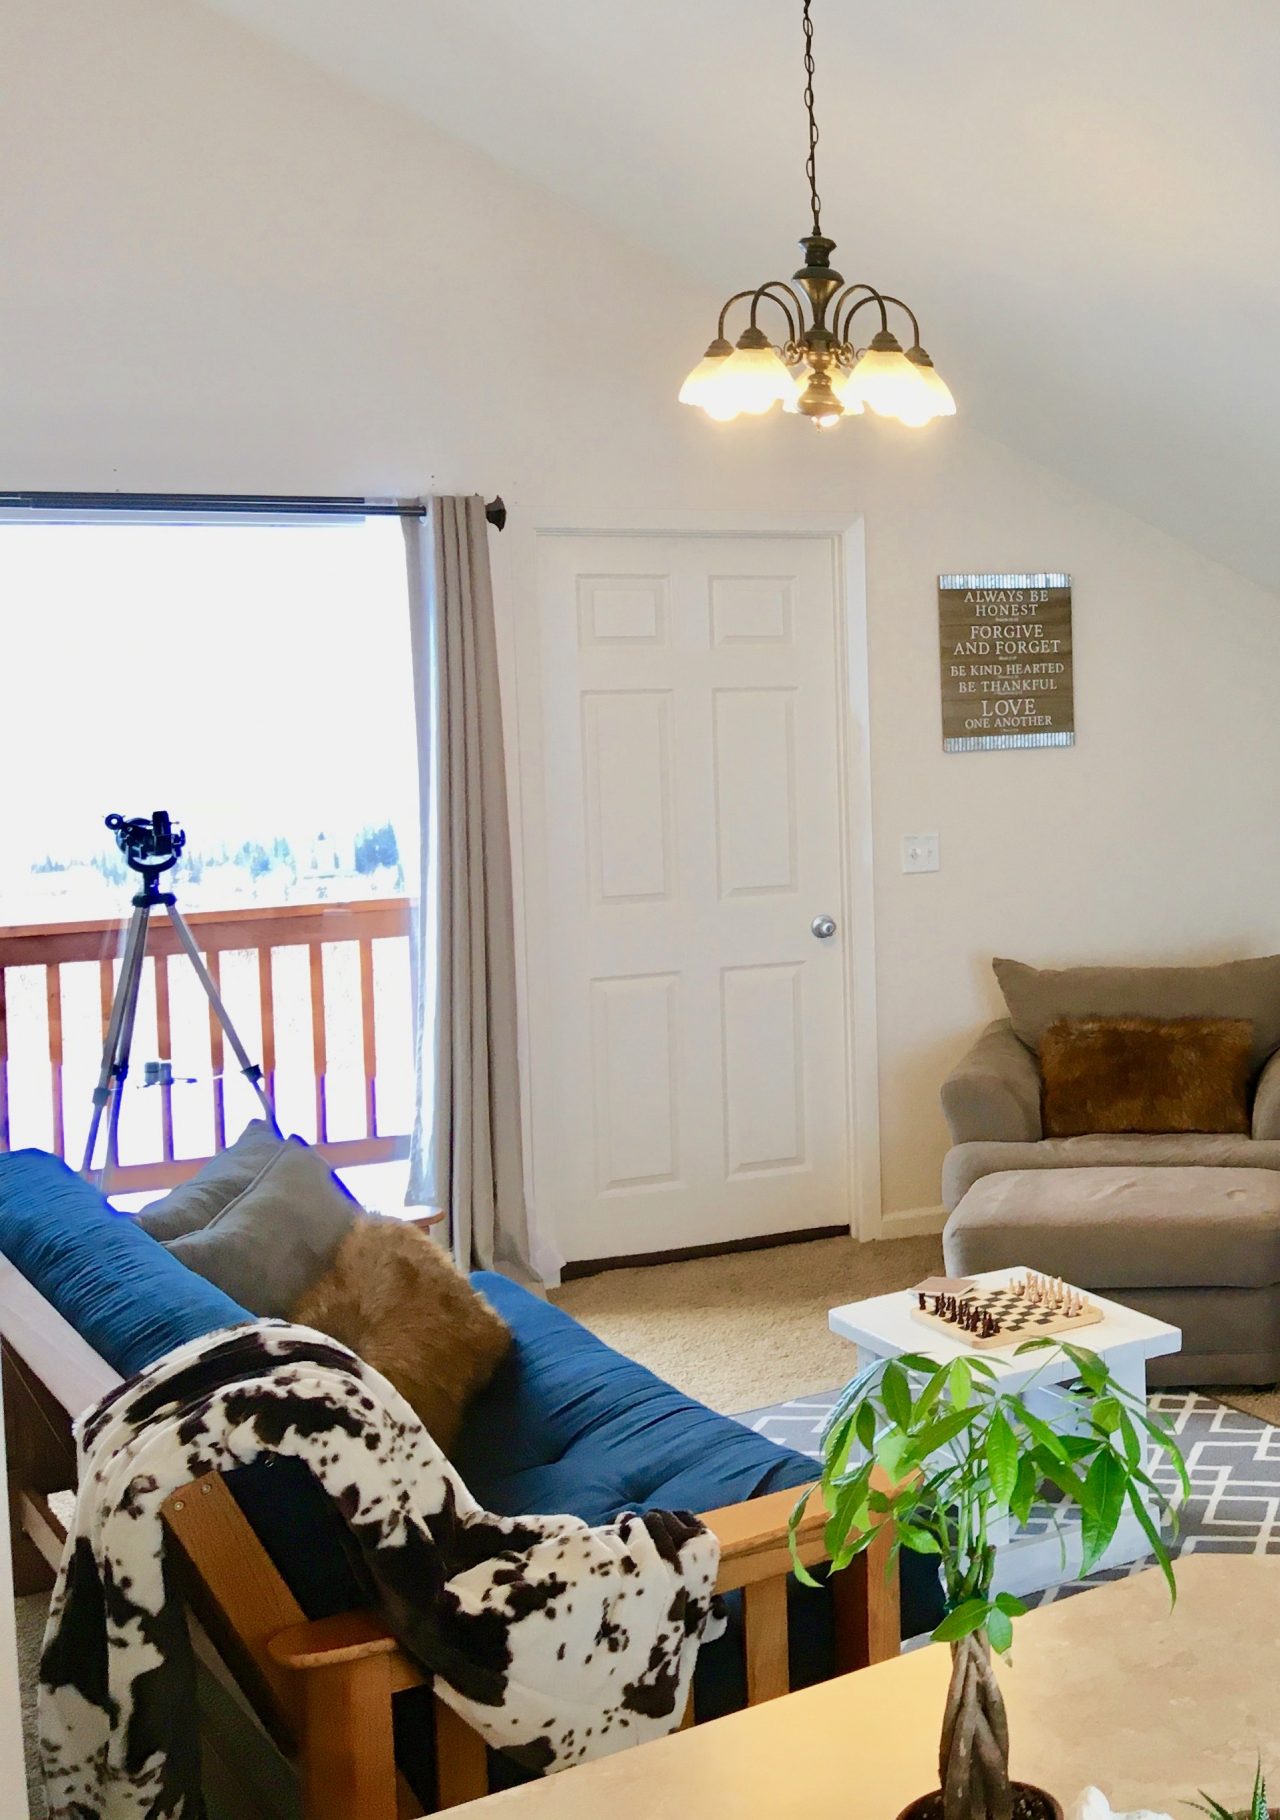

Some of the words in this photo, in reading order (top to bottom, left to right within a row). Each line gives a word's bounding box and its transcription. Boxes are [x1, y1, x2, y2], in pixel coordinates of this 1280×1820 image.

[964, 590, 1024, 603] ALWAYS
[1030, 590, 1049, 602] BE
[975, 604, 1038, 617] HONEST
[971, 624, 1044, 639] FORGIVE
[953, 642, 990, 656] AND
[995, 640, 1062, 655] FORGET
[951, 666, 966, 677] BE
[970, 665, 1002, 676] KIND
[1006, 663, 1064, 675] HEARTED
[959, 681, 976, 693] BE
[981, 679, 1058, 692] THANKFUL
[981, 698, 1036, 717] LOVE
[964, 718, 990, 729] ONE
[994, 716, 1053, 728] ANOTHER
